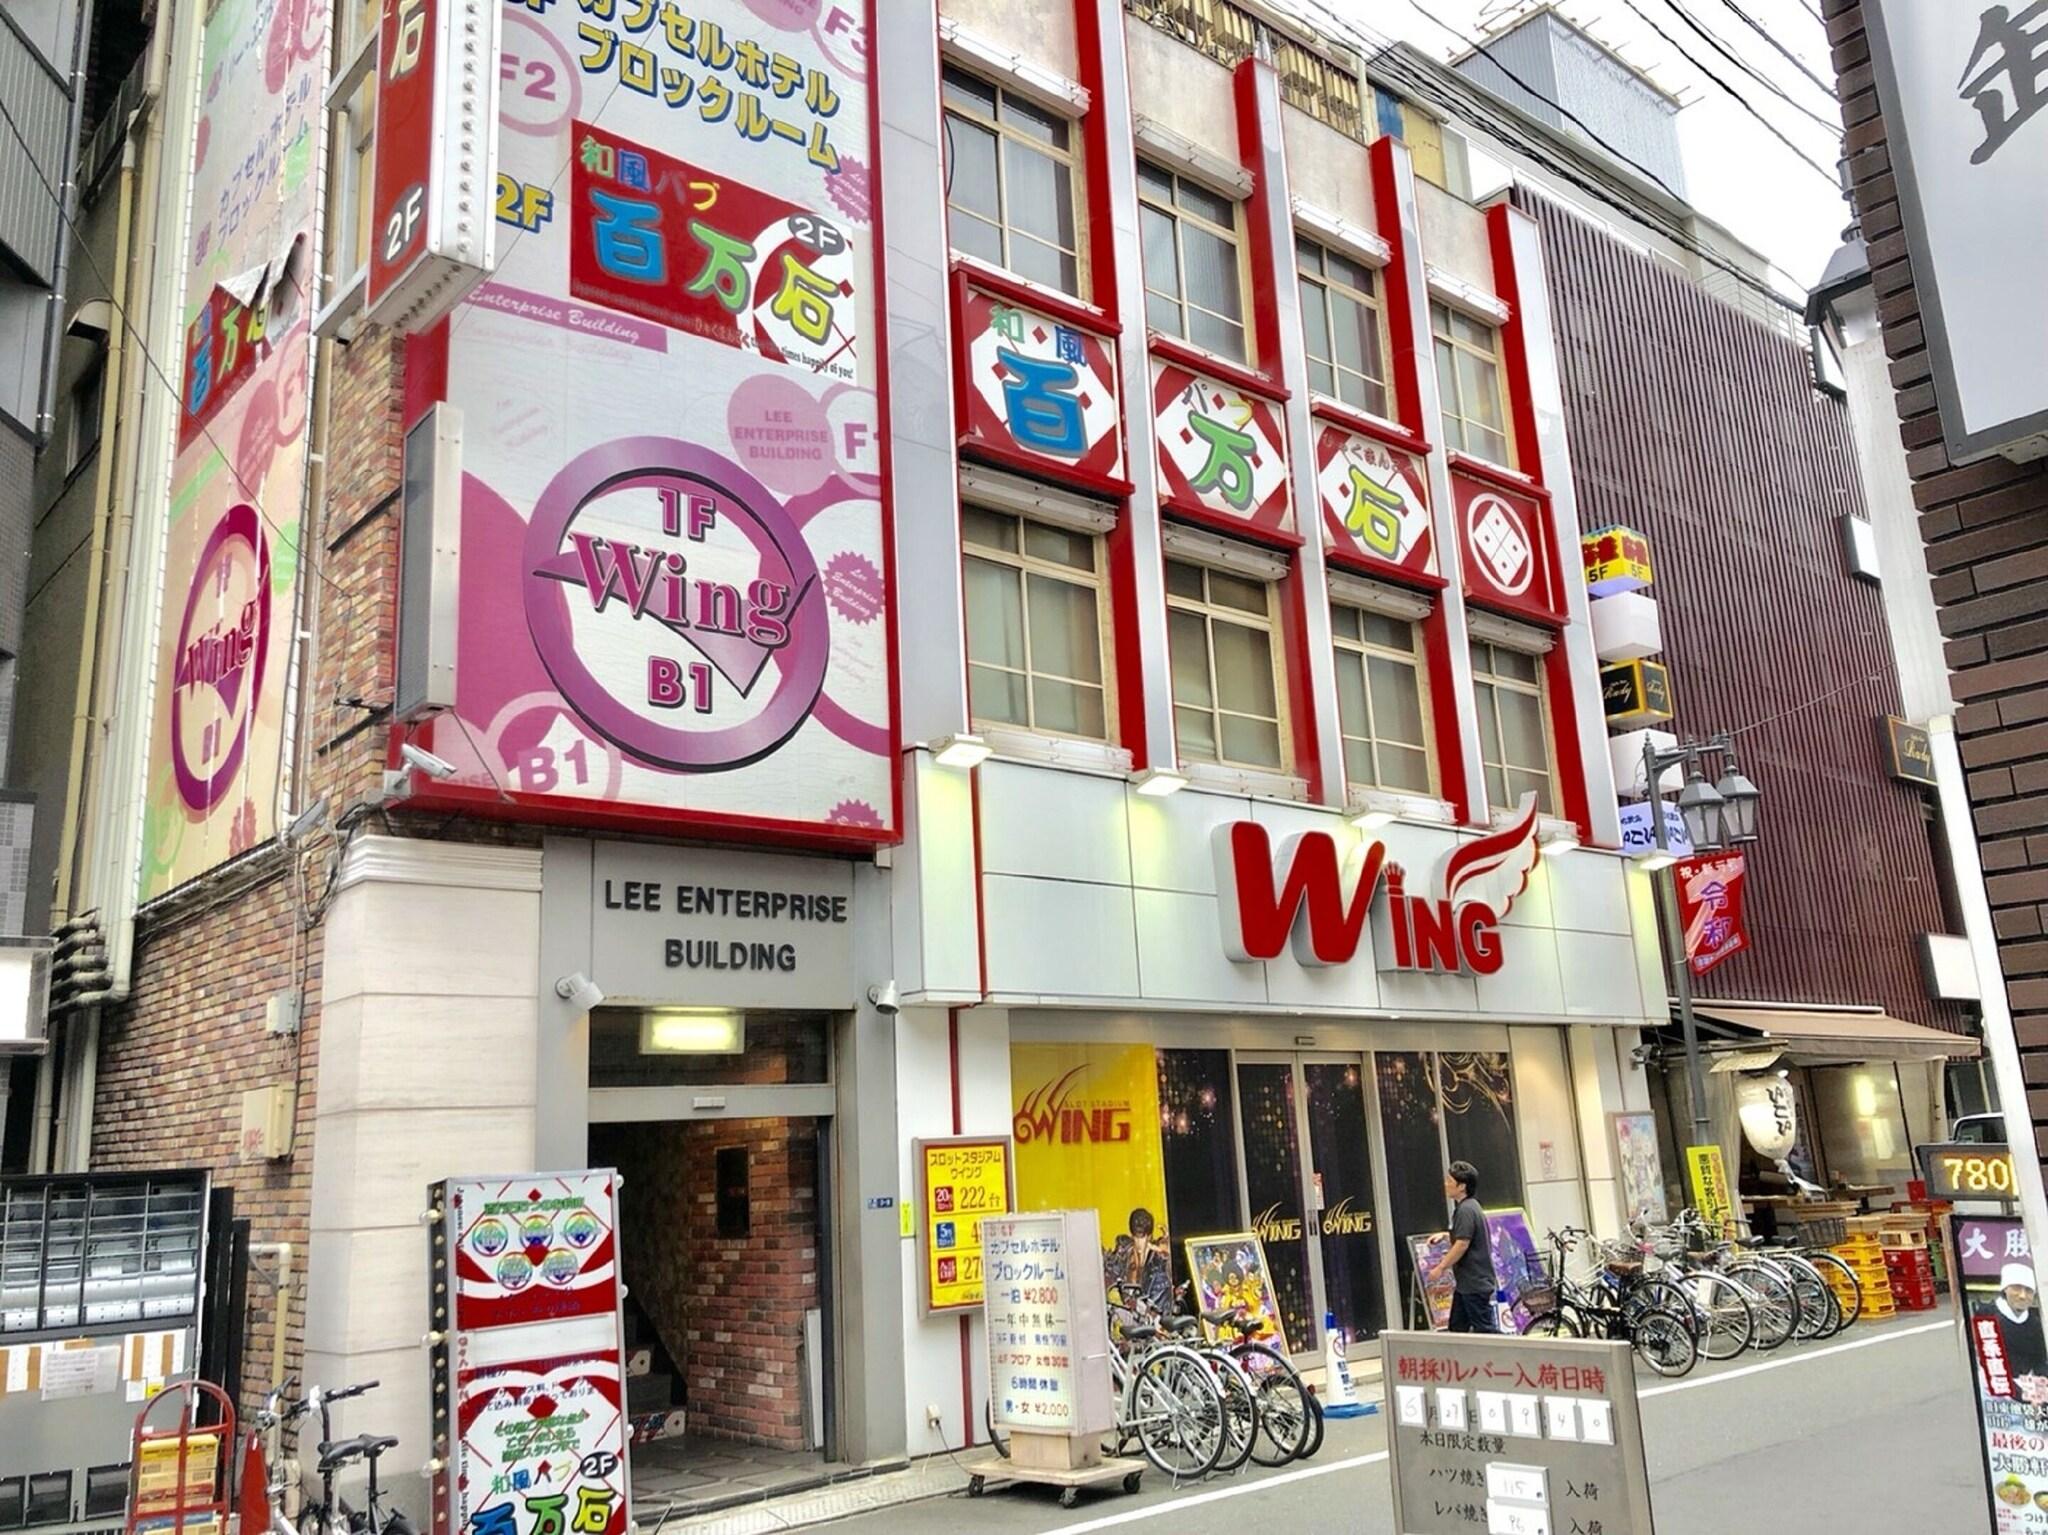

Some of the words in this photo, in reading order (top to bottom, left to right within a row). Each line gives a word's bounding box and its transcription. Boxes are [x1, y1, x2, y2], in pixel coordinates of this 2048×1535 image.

[578, 22, 842, 174] ブロックルーム
[496, 172, 554, 234] 2F
[386, 187, 423, 262] 2F
[793, 217, 840, 250] 2F
[589, 187, 843, 347] 百万石
[567, 307, 640, 344] Building
[764, 410, 793, 423] LEE
[997, 345, 1089, 457] 百
[734, 426, 828, 443] ENTERPRISE
[749, 445, 822, 461] BUILDING
[844, 423, 880, 459] F
[1187, 410, 1258, 512] 万
[659, 487, 715, 541] 1F
[1345, 463, 1405, 561] 石
[568, 533, 793, 648] Wing
[1588, 565, 1608, 582] 5F
[648, 656, 714, 714] B1
[518, 739, 589, 793] B1
[605, 879, 662, 912] LEE
[676, 885, 848, 923] ENTERPRISE
[664, 938, 797, 972] BUILDING
[1943, 1157, 2019, 1193] 780
[960, 1186, 986, 1210] 222
[991, 1260, 1065, 1281] ブロックルーム
[1397, 1355, 1608, 1395] 朝採りレバー入荷日時
[583, 1454, 613, 1478] 2F
[1429, 1468, 1485, 1488] ハツ焼き
[1565, 1480, 1599, 1501] 入荷
